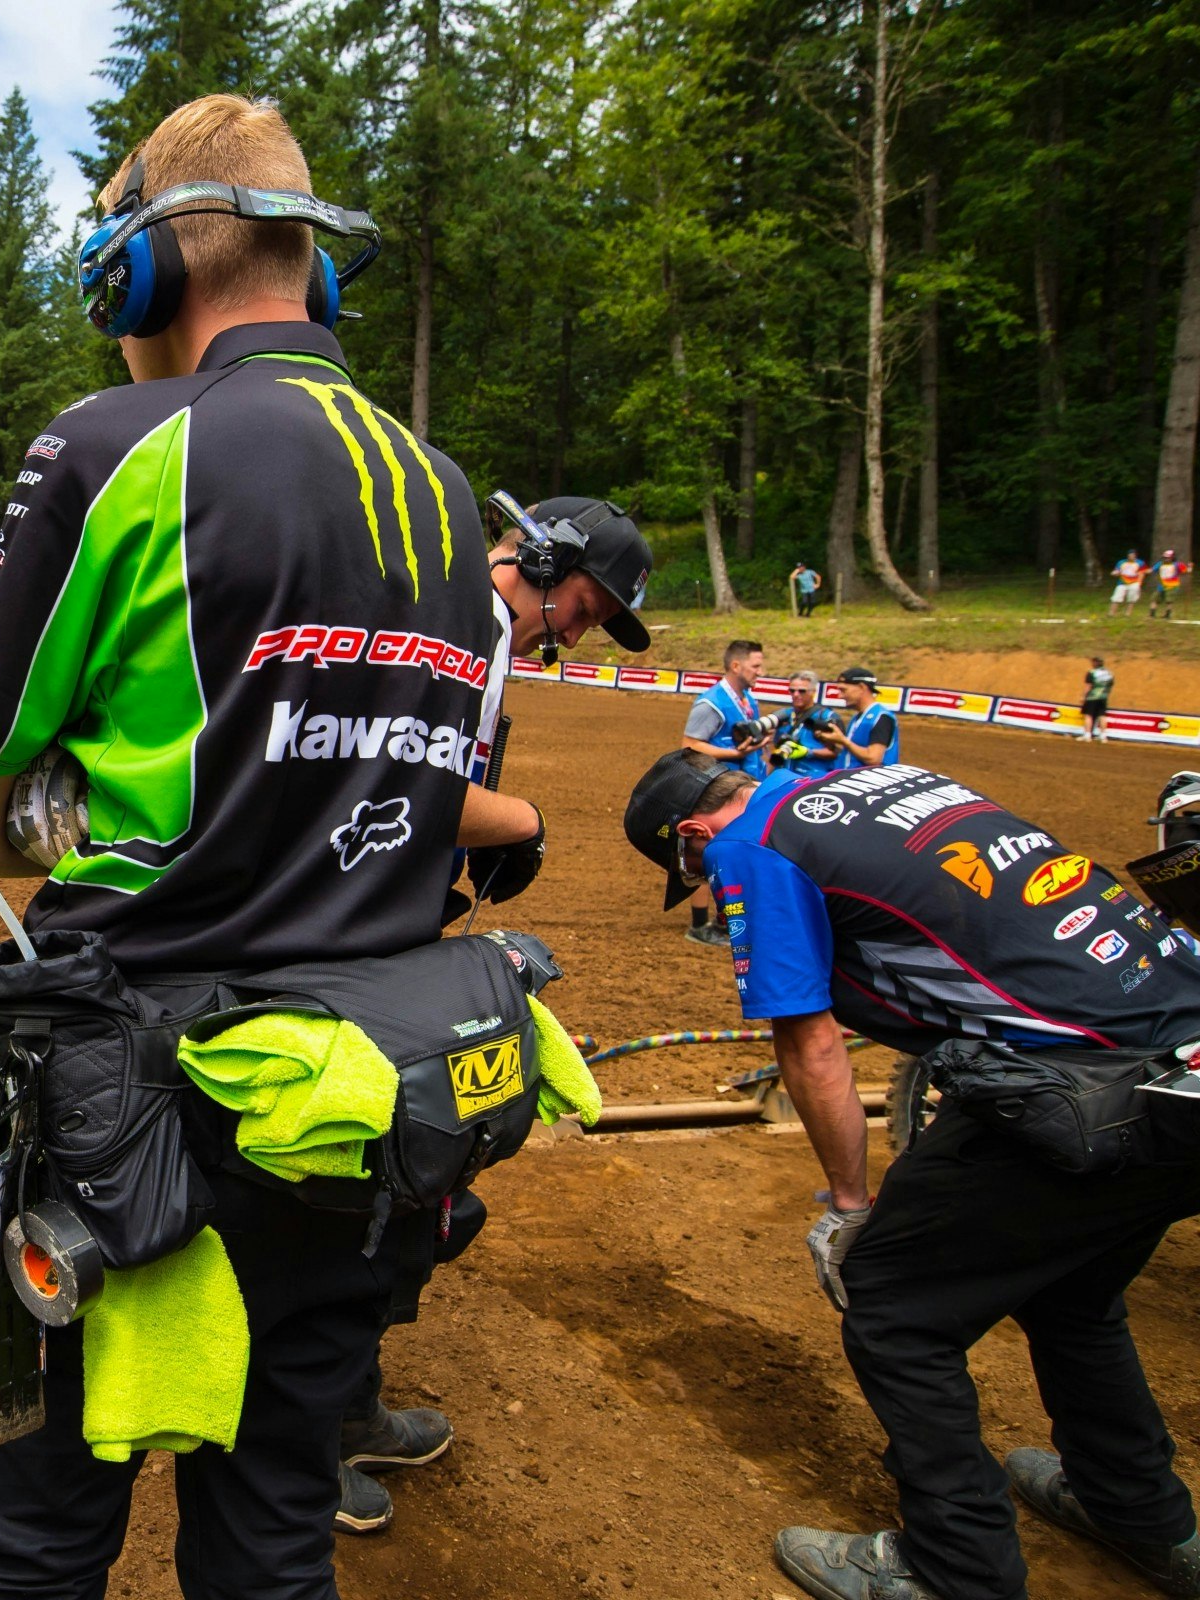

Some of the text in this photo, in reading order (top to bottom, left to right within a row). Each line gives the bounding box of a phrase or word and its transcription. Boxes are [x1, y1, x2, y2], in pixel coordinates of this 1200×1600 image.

[16, 470, 43, 486] LOP
[241, 624, 488, 690] PRO CIRCU
[265, 699, 478, 779] Kawasaki
[818, 763, 930, 797] YAMAH
[1028, 855, 1087, 906] FMF
[1057, 910, 1094, 935] BELL
[1095, 934, 1124, 959] 100%
